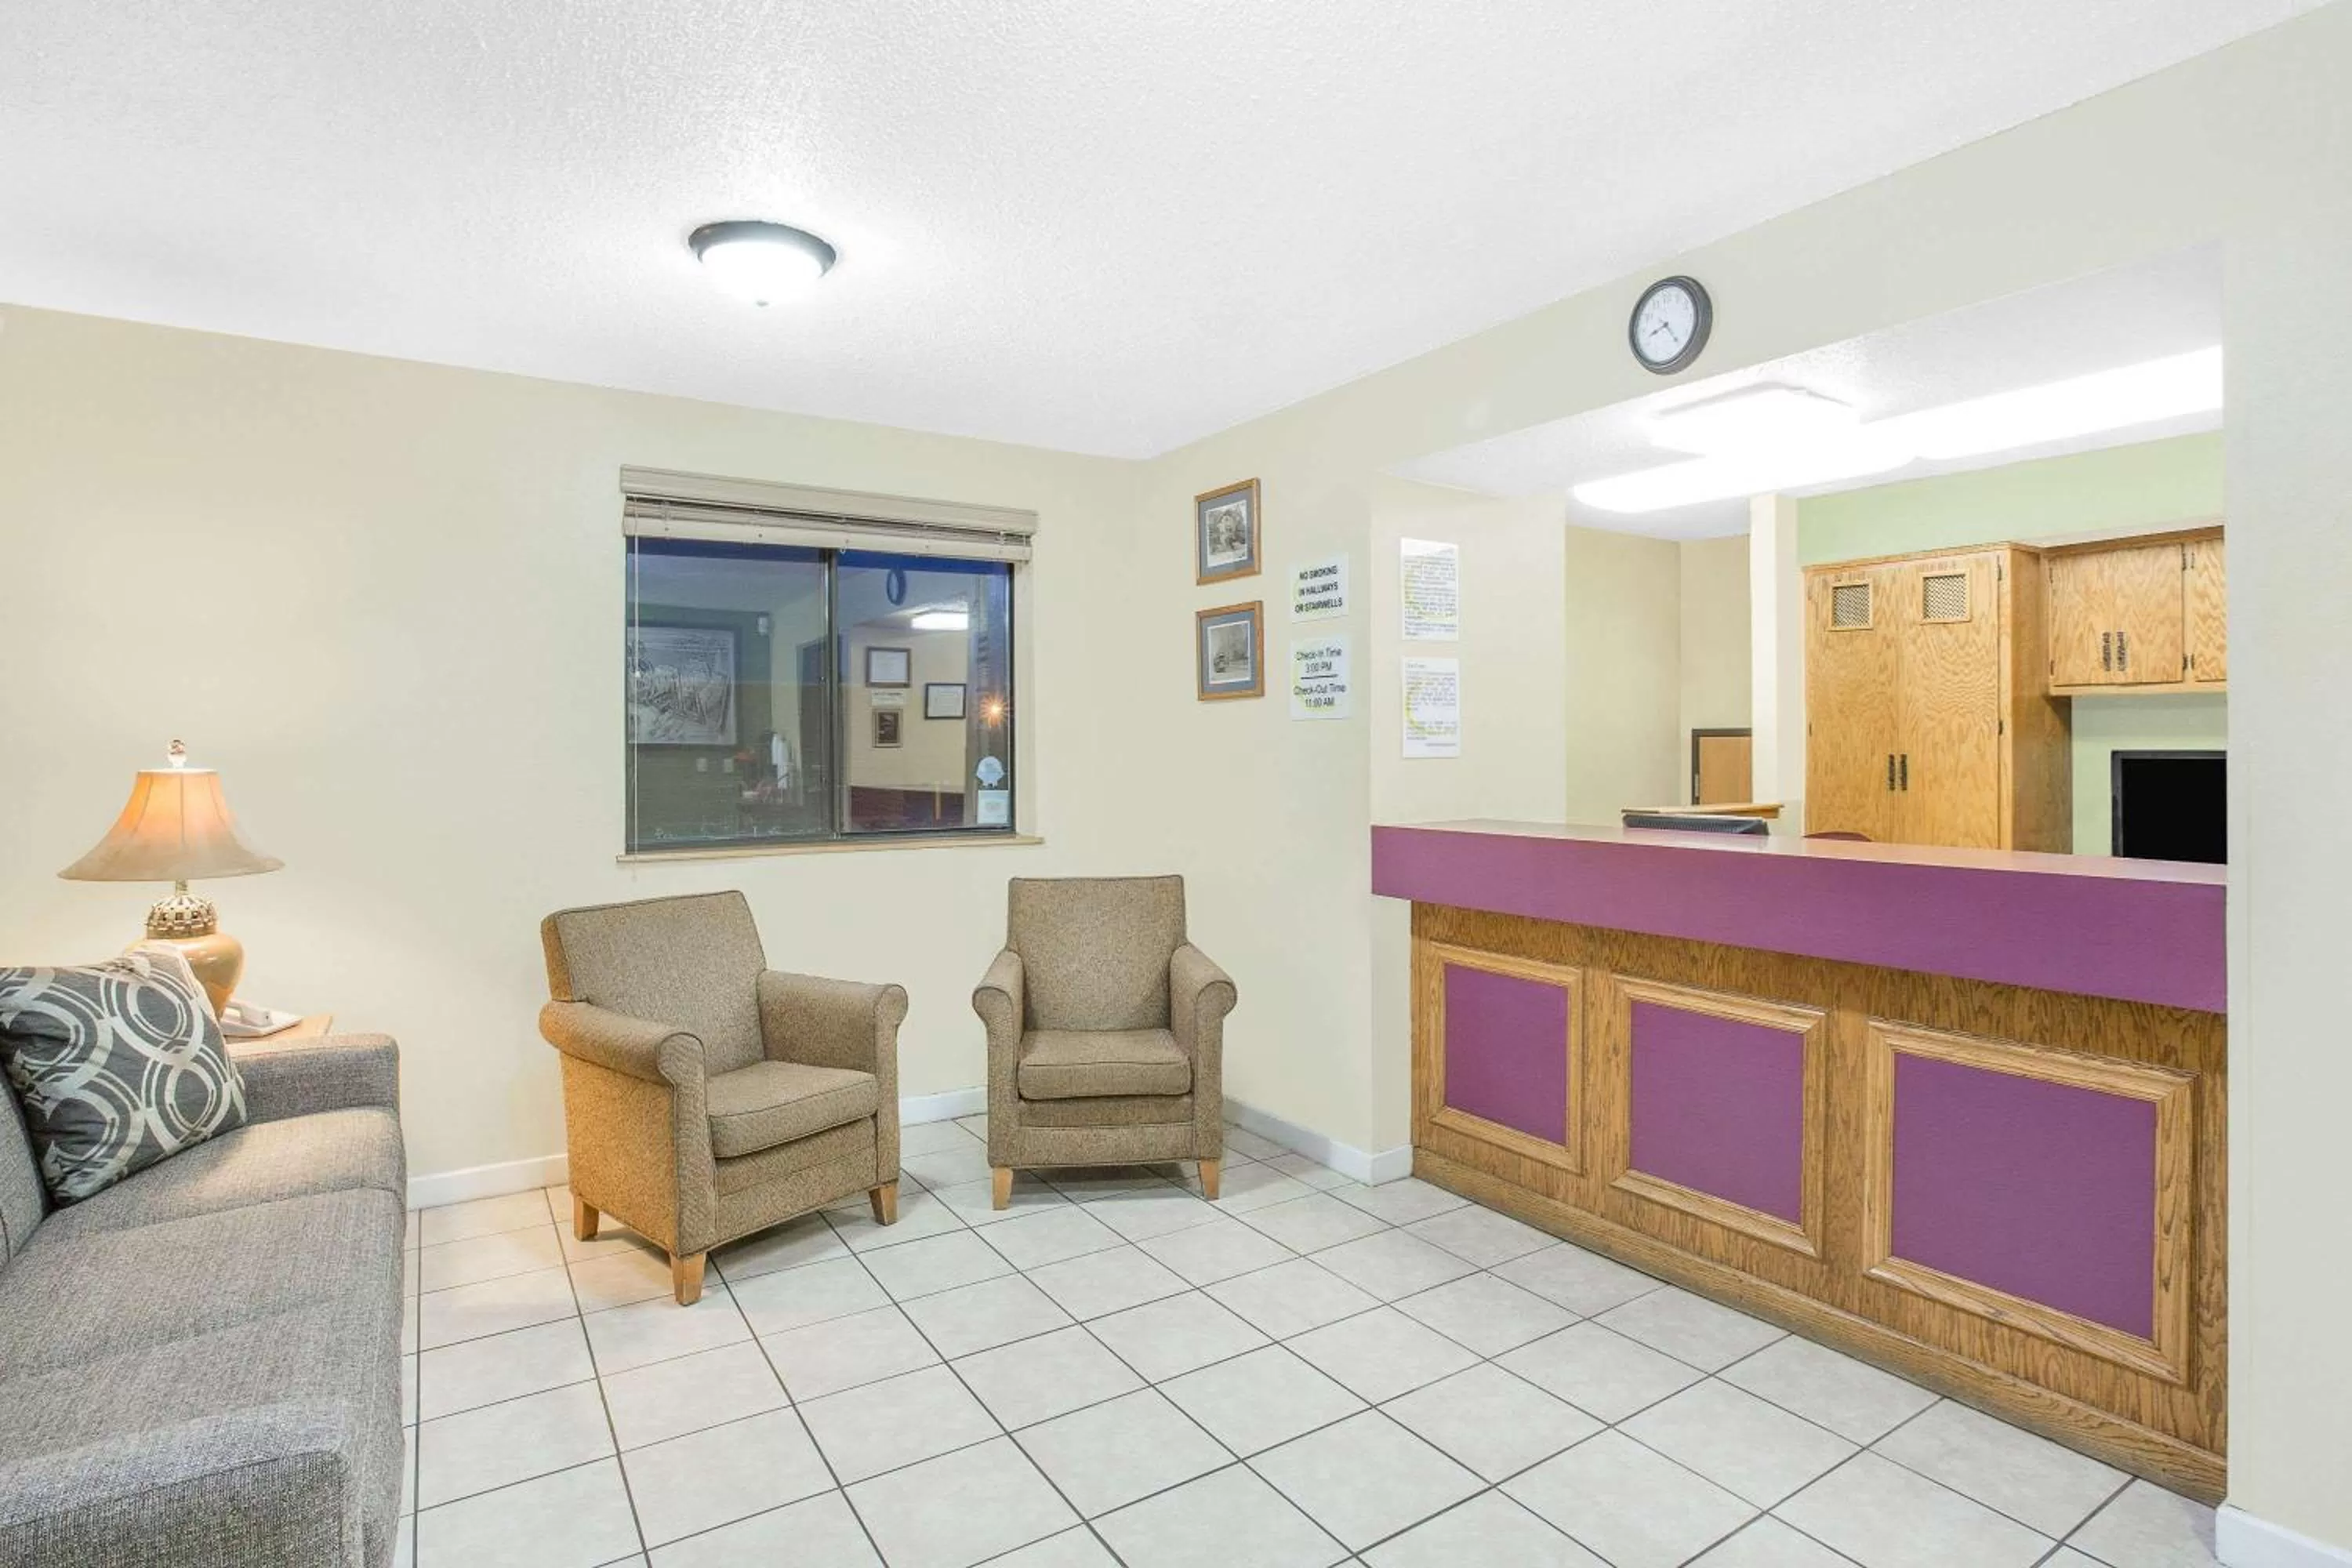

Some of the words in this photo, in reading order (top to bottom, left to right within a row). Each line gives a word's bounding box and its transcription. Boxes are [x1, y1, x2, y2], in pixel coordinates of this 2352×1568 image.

[1299, 571, 1308, 580] NO
[1309, 565, 1338, 579] SMOKING
[1305, 582, 1338, 595] HALLWAYS
[1294, 604, 1304, 613] OR
[1326, 647, 1341, 657] Time
[1320, 661, 1332, 671] PM
[1330, 683, 1346, 693] Time
[1323, 696, 1335, 706] AM
